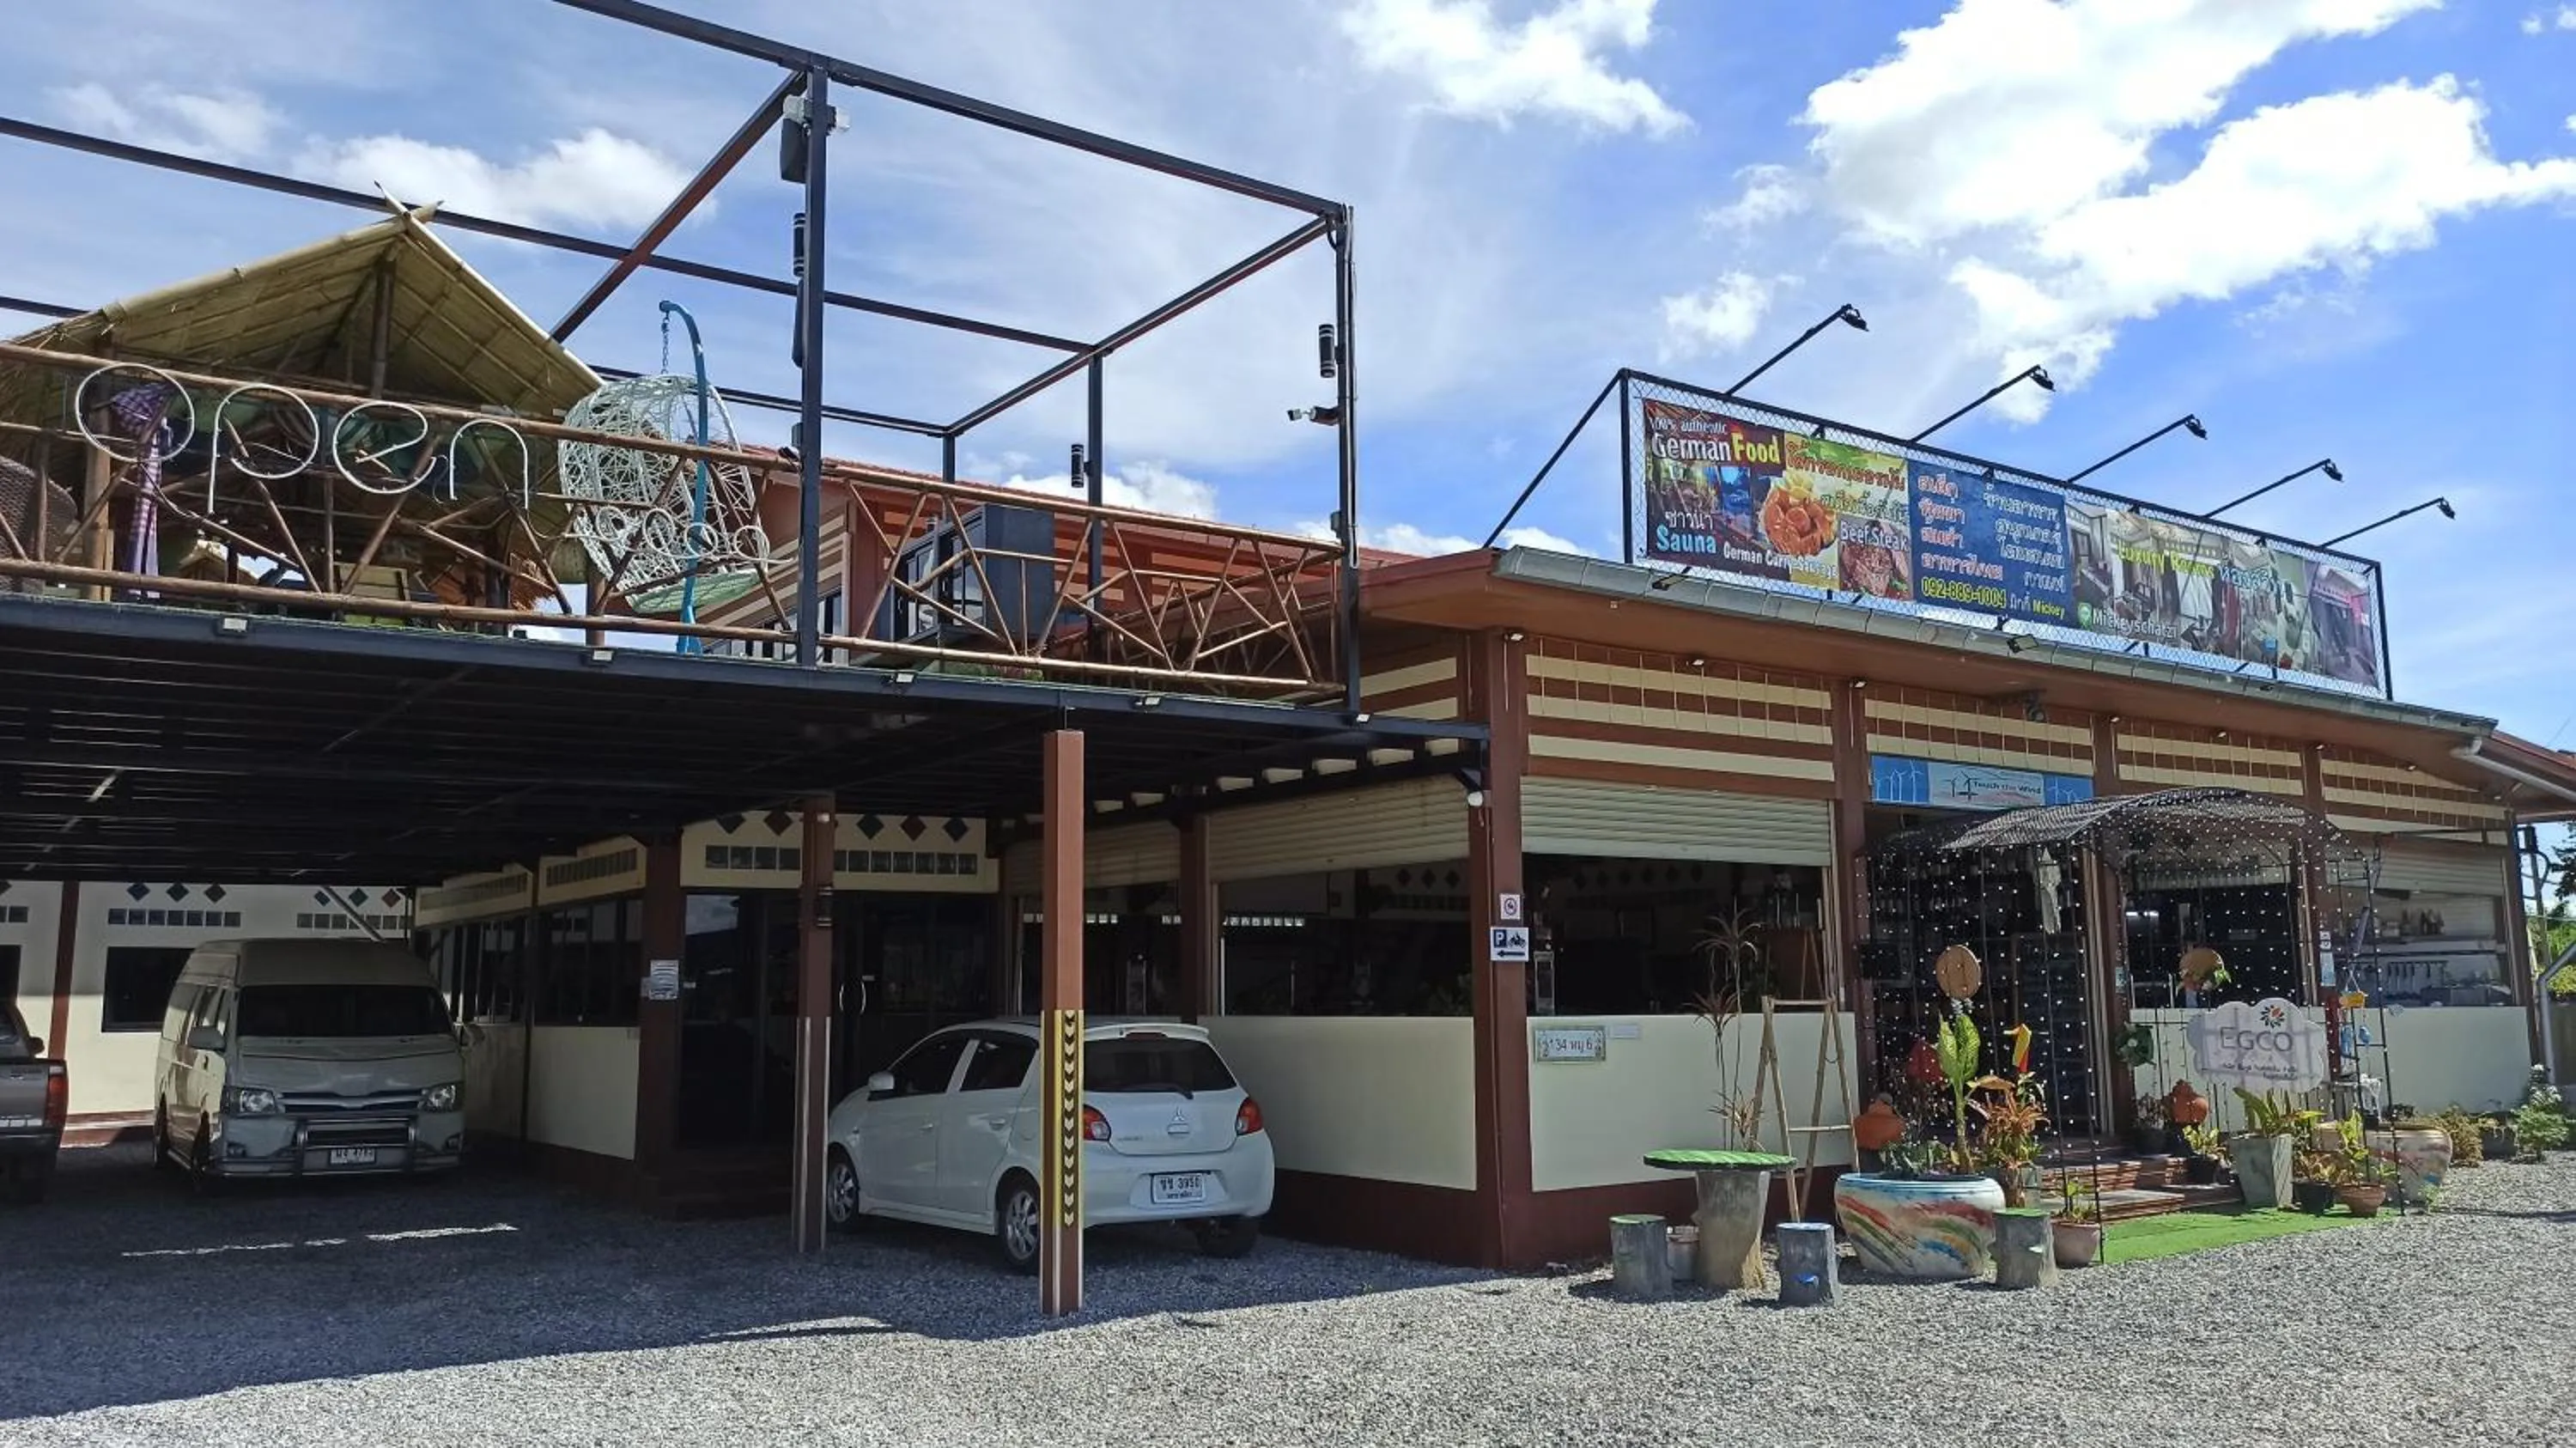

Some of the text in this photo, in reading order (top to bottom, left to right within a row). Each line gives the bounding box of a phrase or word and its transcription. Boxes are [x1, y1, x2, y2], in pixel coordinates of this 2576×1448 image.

[1652, 431, 1781, 465] German Food
[1656, 524, 1716, 553] Sauna
[1841, 519, 1909, 552] Beef Steak
[1723, 541, 1763, 564] German
[2220, 1026, 2293, 1052] EGCO
